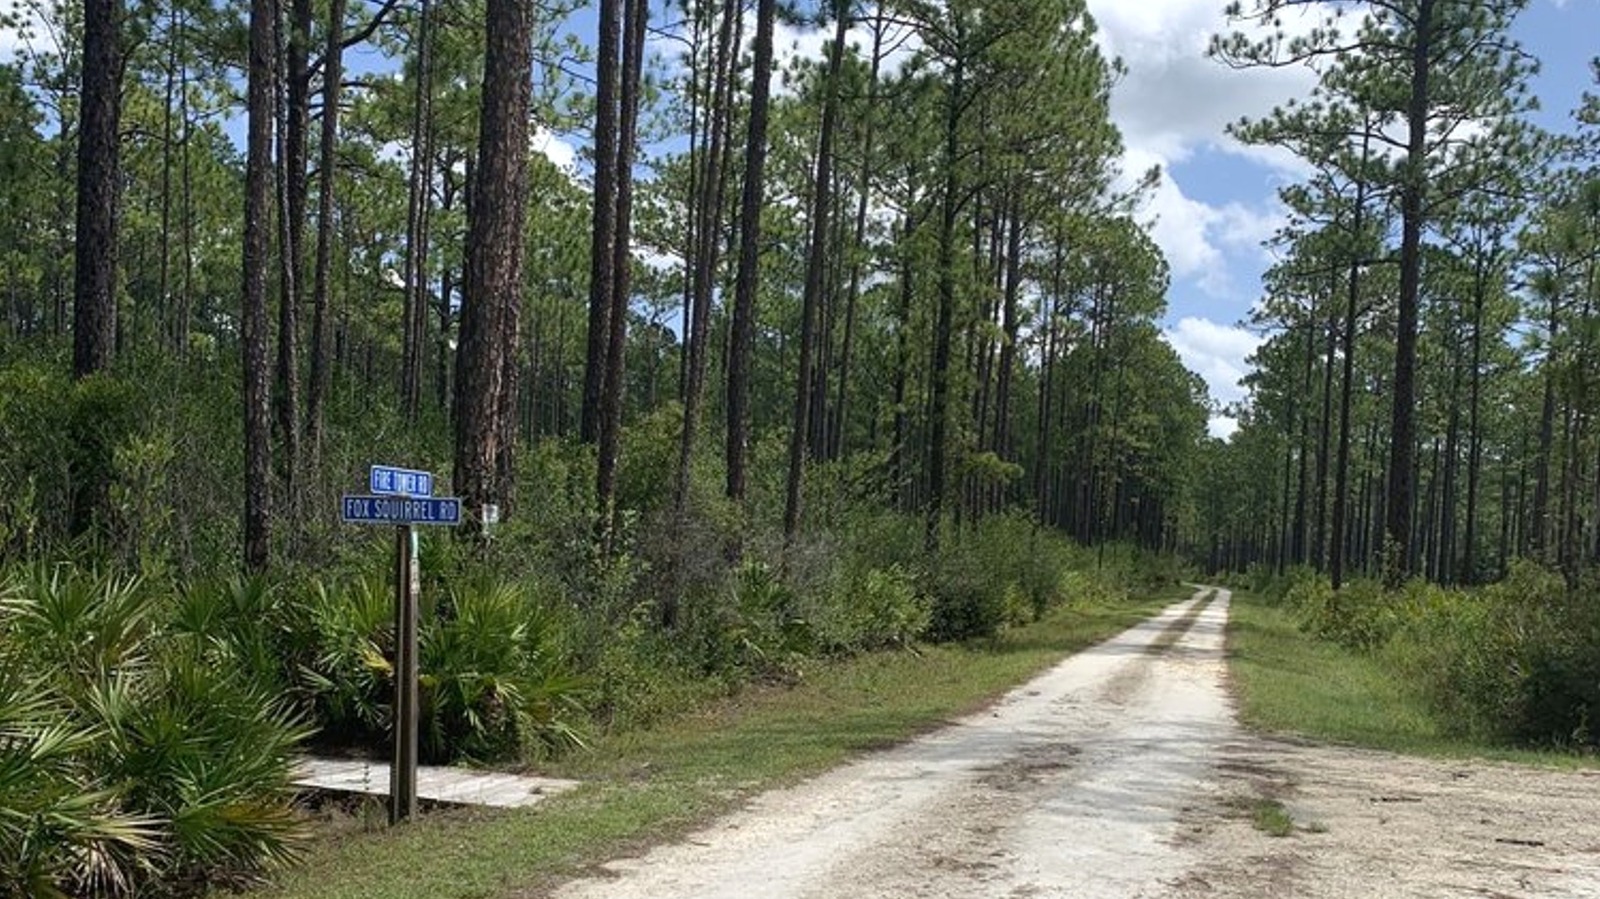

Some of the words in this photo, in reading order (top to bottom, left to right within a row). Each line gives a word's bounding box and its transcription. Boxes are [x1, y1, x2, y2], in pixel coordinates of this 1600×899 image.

[374, 469, 391, 490] FIRE
[346, 499, 370, 518] FOX
[374, 499, 435, 519] SQUIRREL
[439, 501, 457, 520] RD
